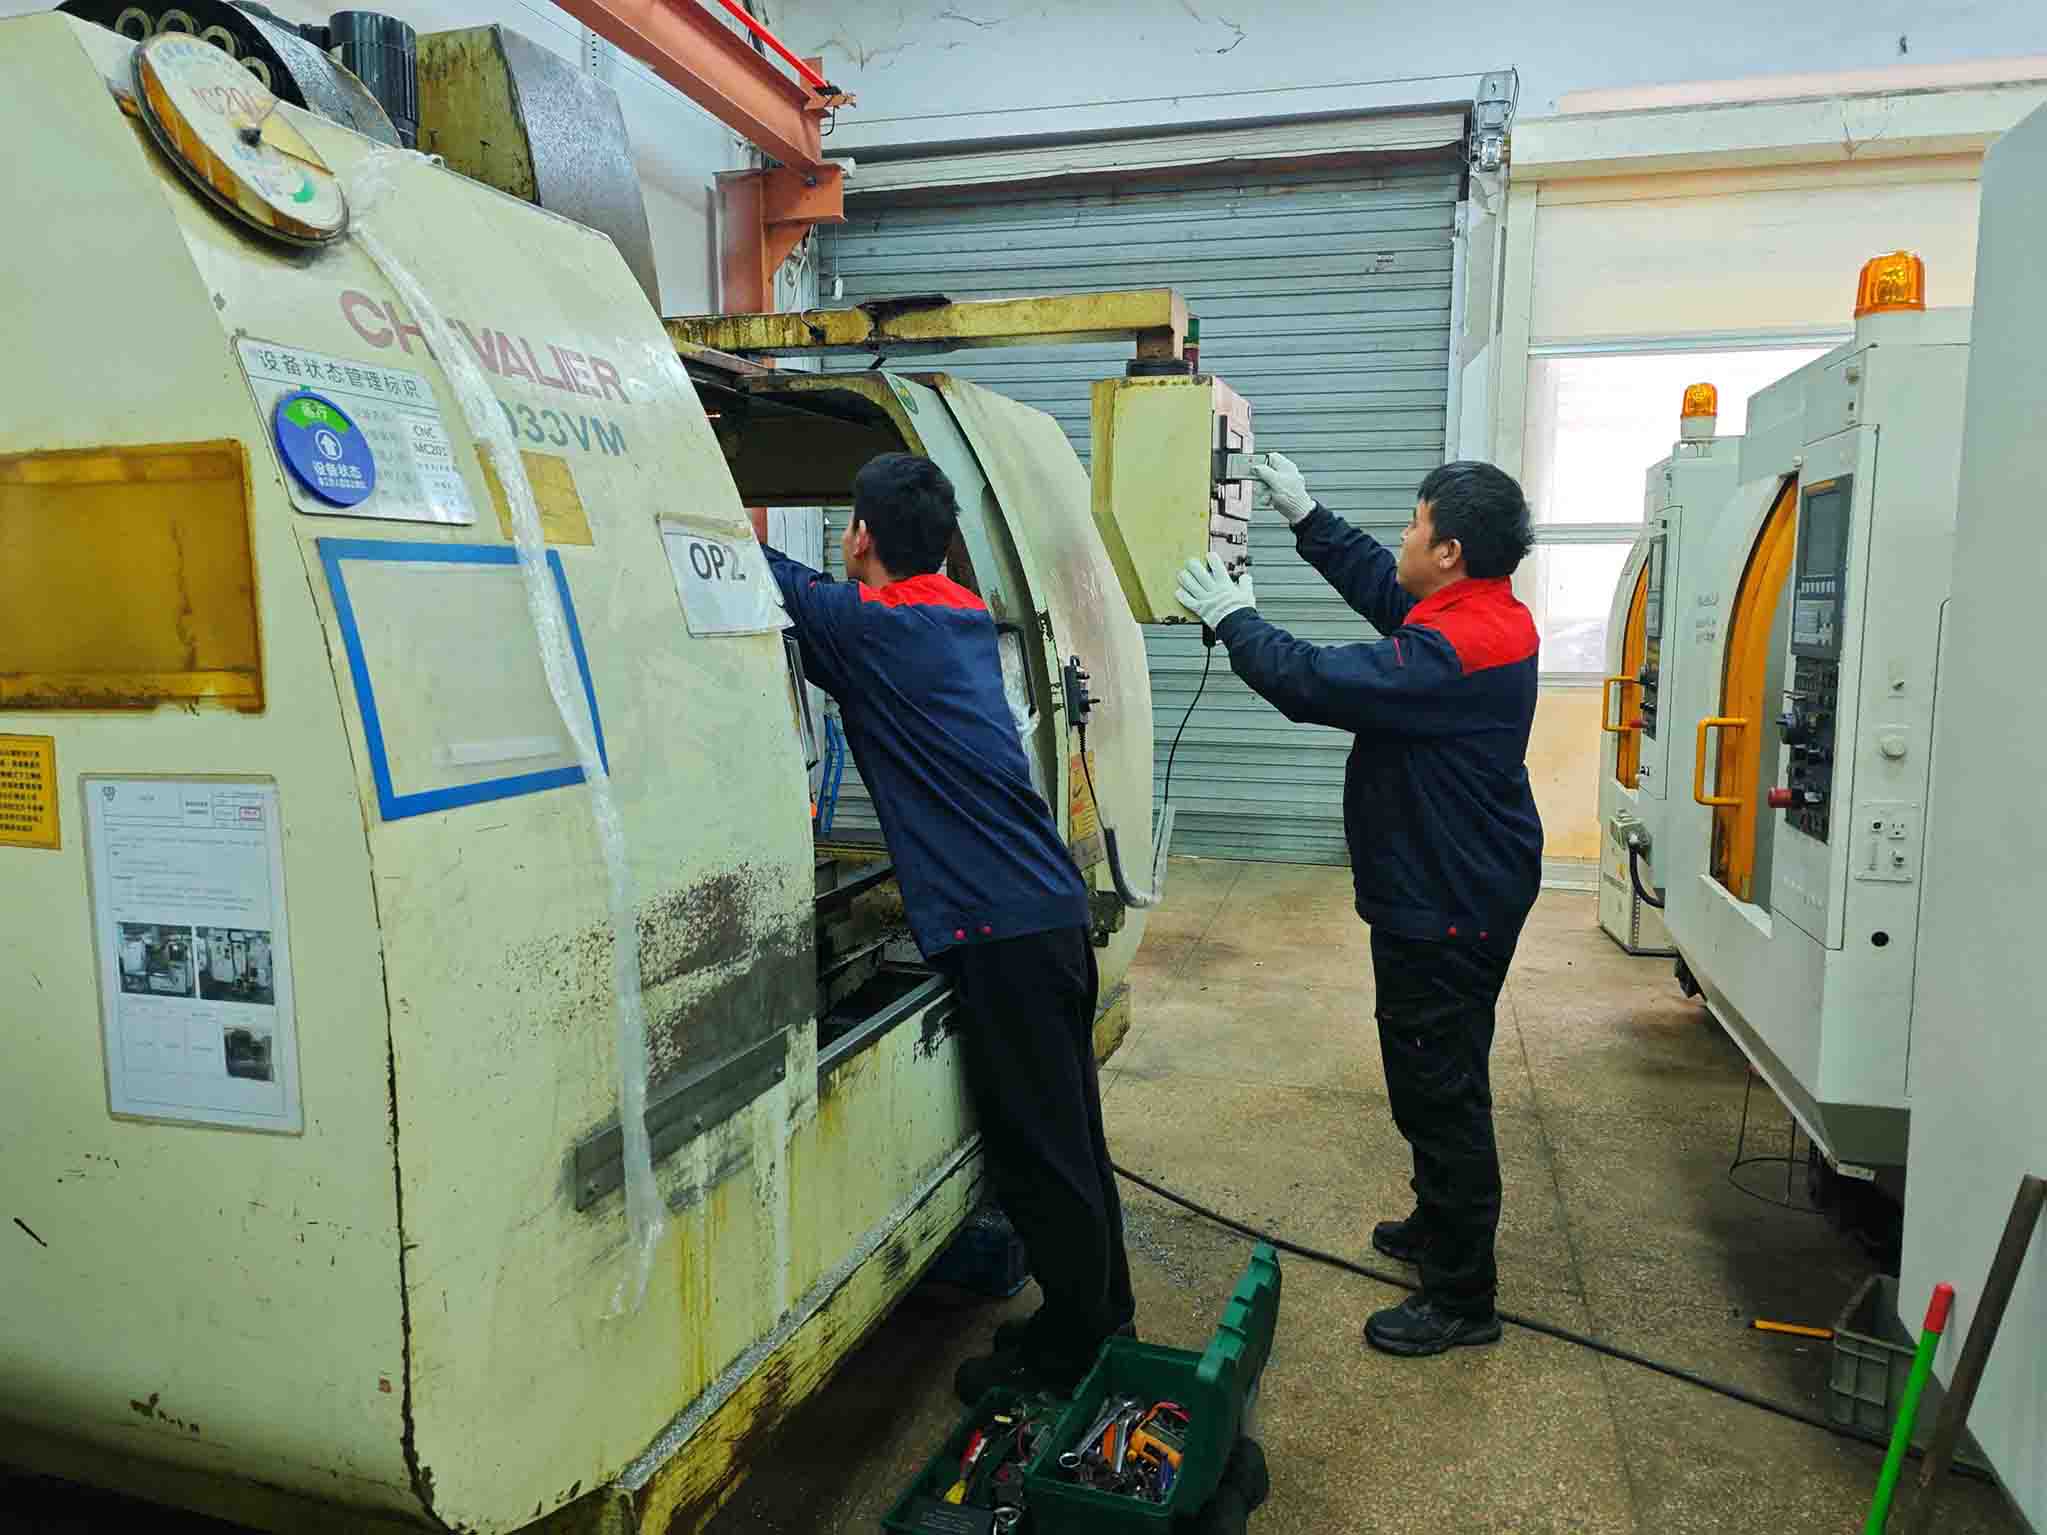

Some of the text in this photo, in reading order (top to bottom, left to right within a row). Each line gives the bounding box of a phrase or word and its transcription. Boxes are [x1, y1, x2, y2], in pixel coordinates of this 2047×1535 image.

[339, 289, 631, 404] CHVALIER
[258, 349, 423, 398] 设备状态管理标识
[689, 542, 747, 581] OP2
